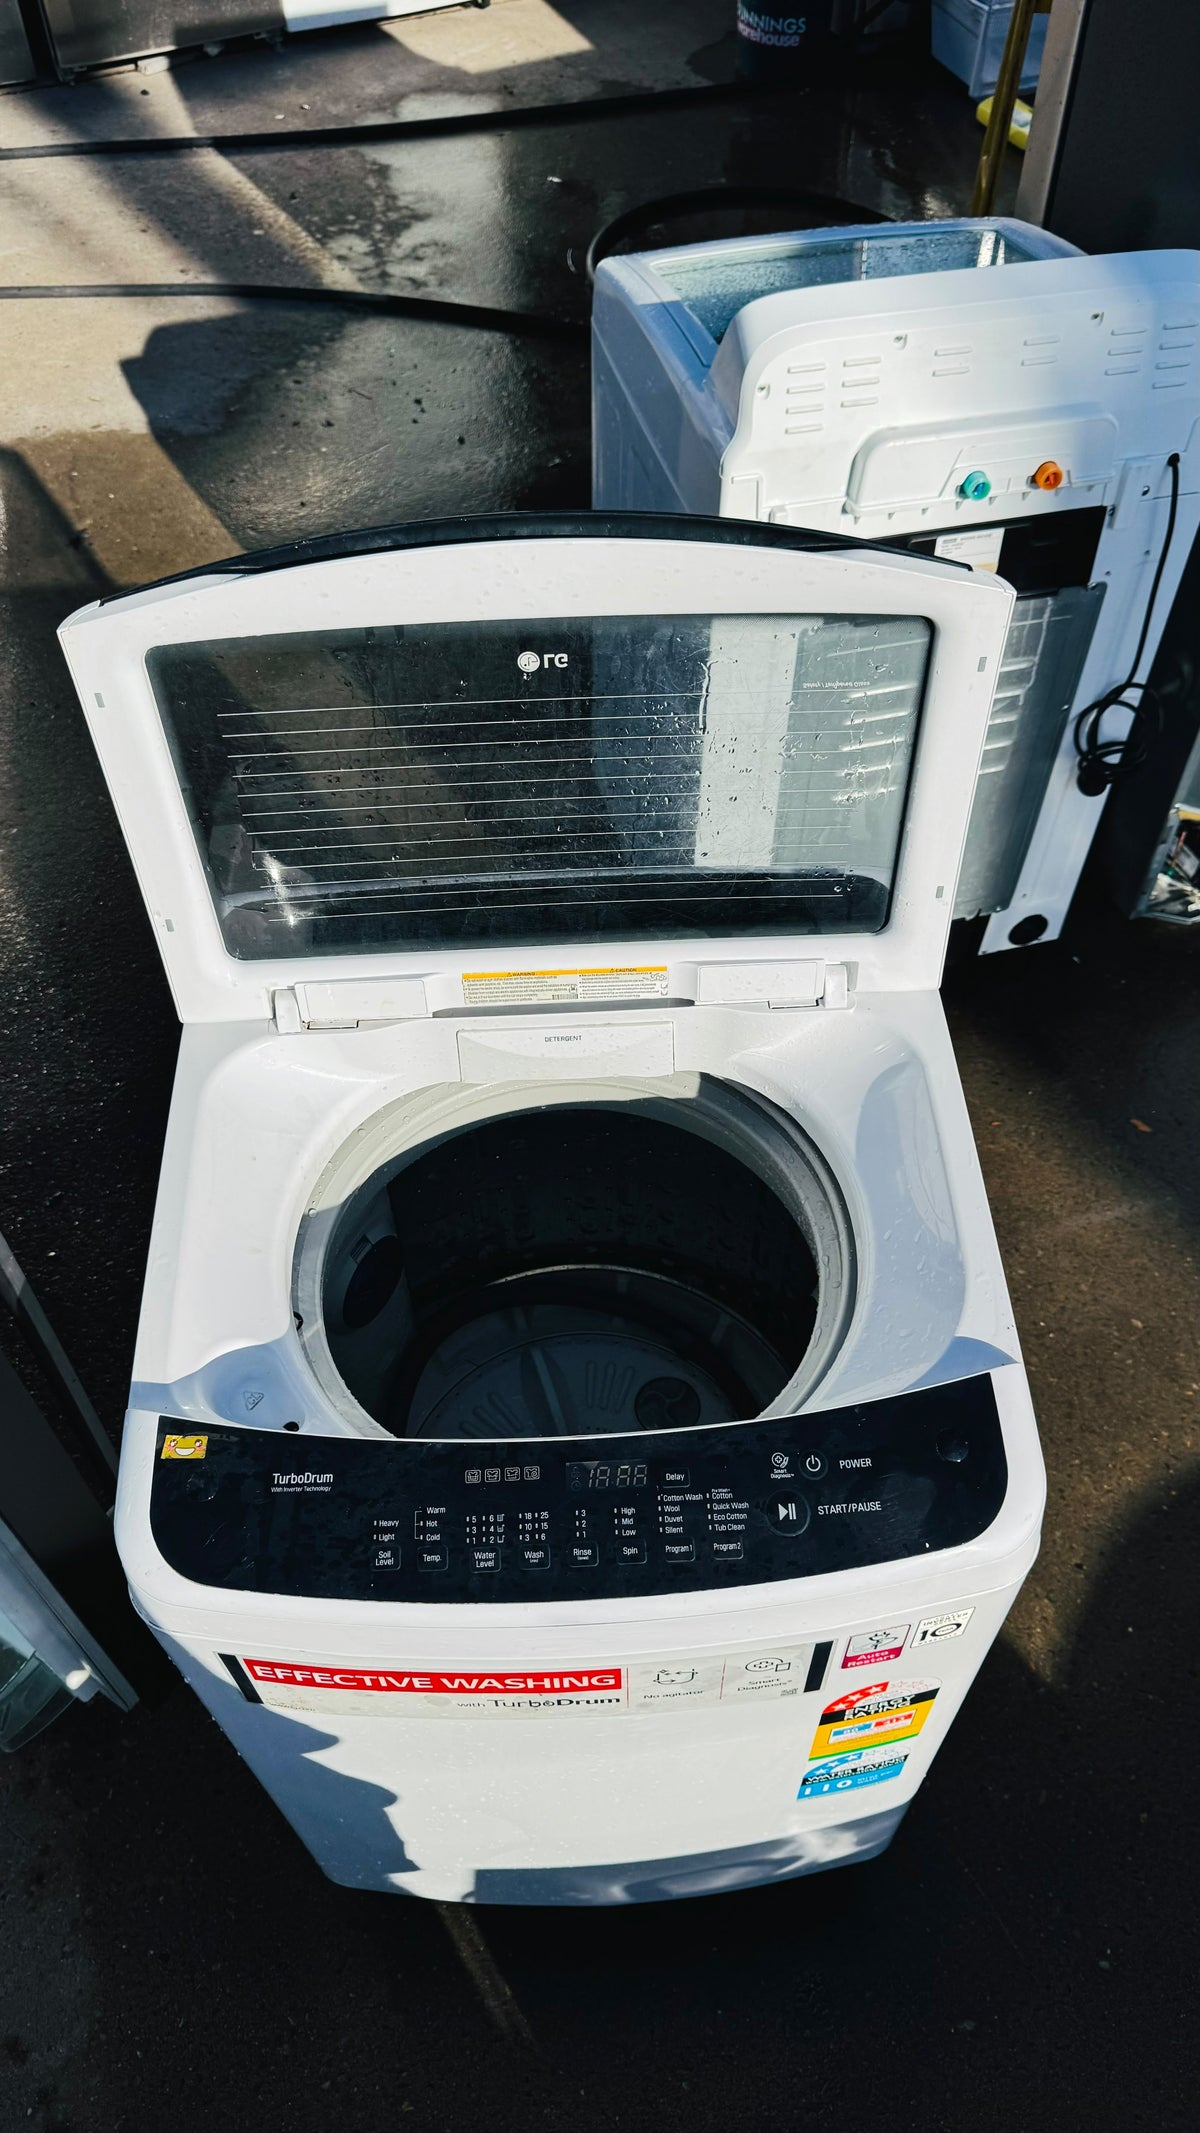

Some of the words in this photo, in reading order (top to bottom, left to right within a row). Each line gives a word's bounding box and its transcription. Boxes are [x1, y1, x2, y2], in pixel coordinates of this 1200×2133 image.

[737, 5, 806, 33] UNNINGS
[544, 1034, 583, 1043] DETERGENT
[839, 1458, 872, 1470] POWER
[272, 1472, 334, 1485] TurboDrum
[665, 1473, 685, 1482] Delay
[304, 1485, 332, 1493] Technology
[663, 1494, 684, 1502] Cotton
[685, 1493, 703, 1501] Wash
[712, 1492, 733, 1500] Cotton
[426, 1506, 446, 1514] Warm
[664, 1505, 681, 1513] Wool
[712, 1503, 730, 1511] Quick
[731, 1502, 750, 1510] Wash
[817, 1501, 882, 1516] START/PAUSE
[524, 1512, 533, 1520] 18
[621, 1507, 636, 1516] High
[664, 1515, 683, 1523] Duvet
[713, 1513, 726, 1521] Eco
[726, 1512, 748, 1520] Cotton
[379, 1520, 399, 1528] Heavy
[426, 1520, 438, 1528] Hot
[524, 1523, 533, 1531] 10
[540, 1522, 549, 1530] 15
[714, 1524, 727, 1532] Tub
[728, 1523, 746, 1531] Clean
[665, 1526, 683, 1534] Silent
[378, 1533, 395, 1542] Light
[378, 1550, 392, 1559] Soil
[474, 1552, 496, 1560] Water
[524, 1551, 545, 1559] Wash
[573, 1548, 592, 1557] Rinse
[622, 1547, 638, 1556] Spin
[375, 1558, 394, 1566] Level
[476, 1559, 495, 1568] Level
[856, 1651, 889, 1661] Auto
[847, 1654, 896, 1668] Restart
[252, 1665, 434, 1689] EFFECTIVE
[440, 1674, 617, 1690] WASHING
[748, 1677, 781, 1686] Smart
[662, 1690, 704, 1699] agitator
[486, 1698, 621, 1708] TurboDrum
[845, 1694, 916, 1716] ENERGY
